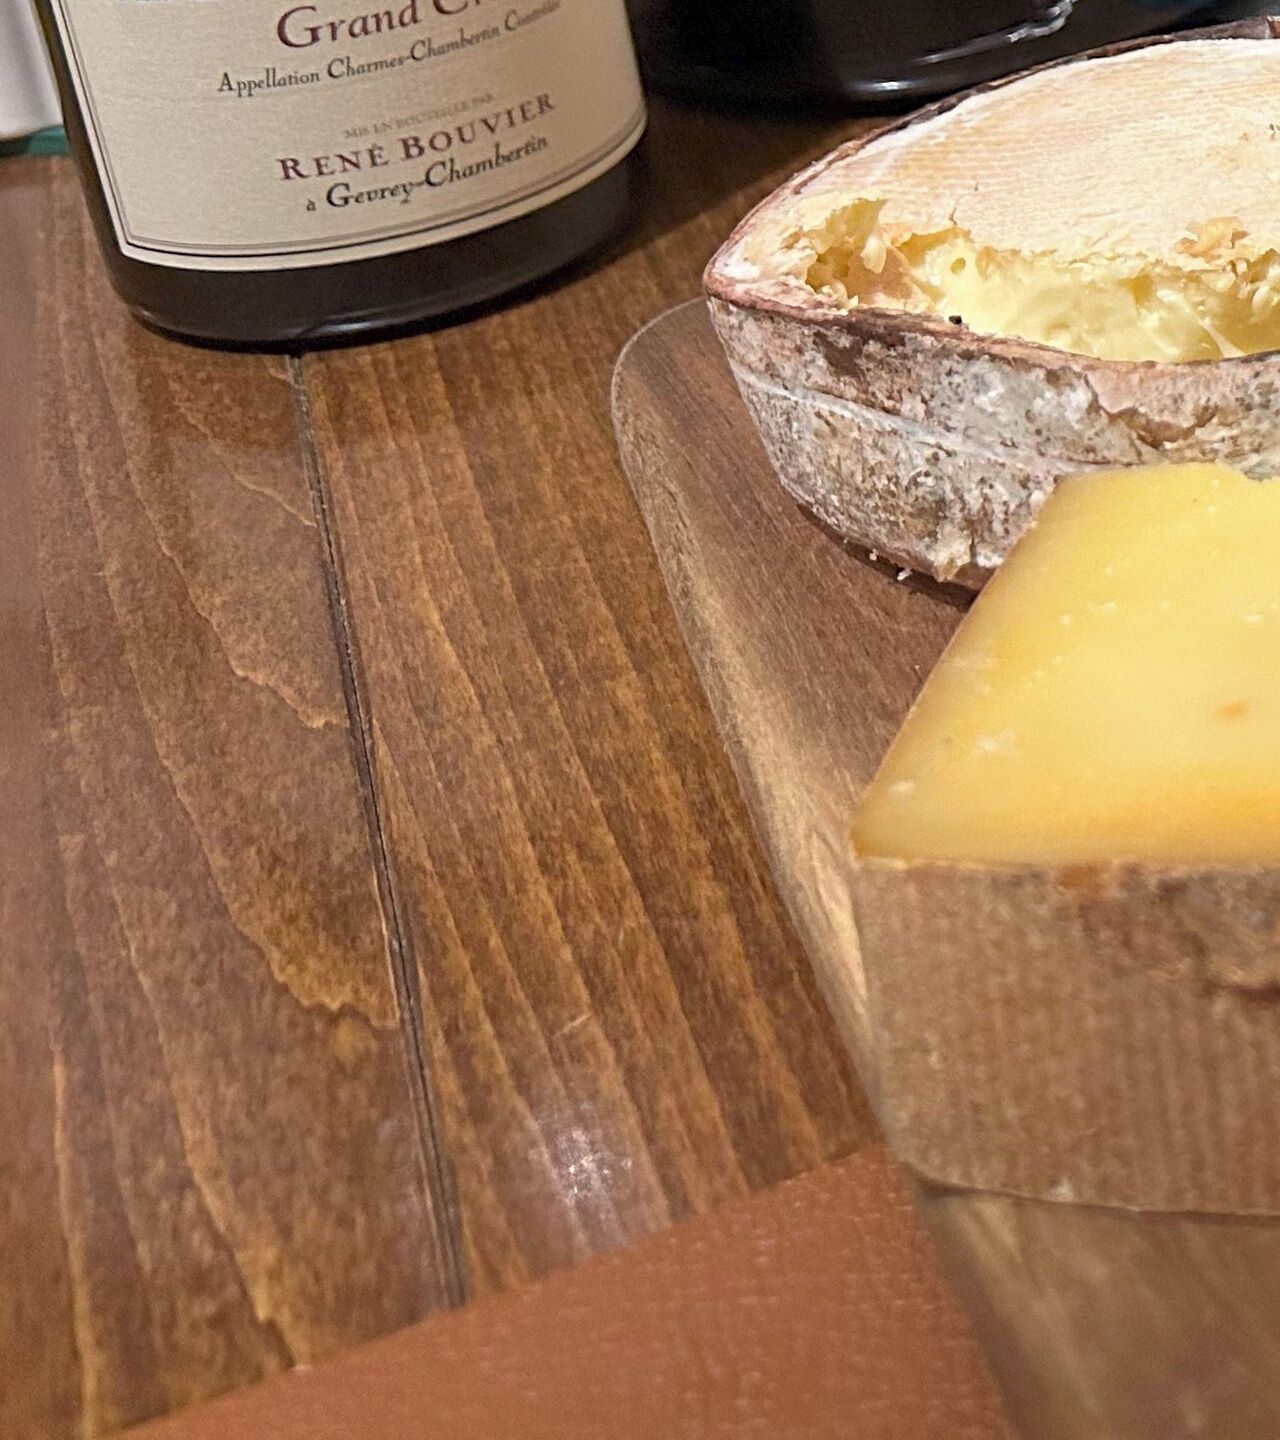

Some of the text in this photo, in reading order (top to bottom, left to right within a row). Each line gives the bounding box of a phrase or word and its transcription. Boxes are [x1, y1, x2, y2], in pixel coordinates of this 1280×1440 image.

[217, 68, 321, 98] Appellation
[326, 21, 500, 81] Charmes-Chambertin
[276, 92, 556, 181] RENÉ BOUVIER
[305, 134, 549, 213] à Gevrey-Chambertin
